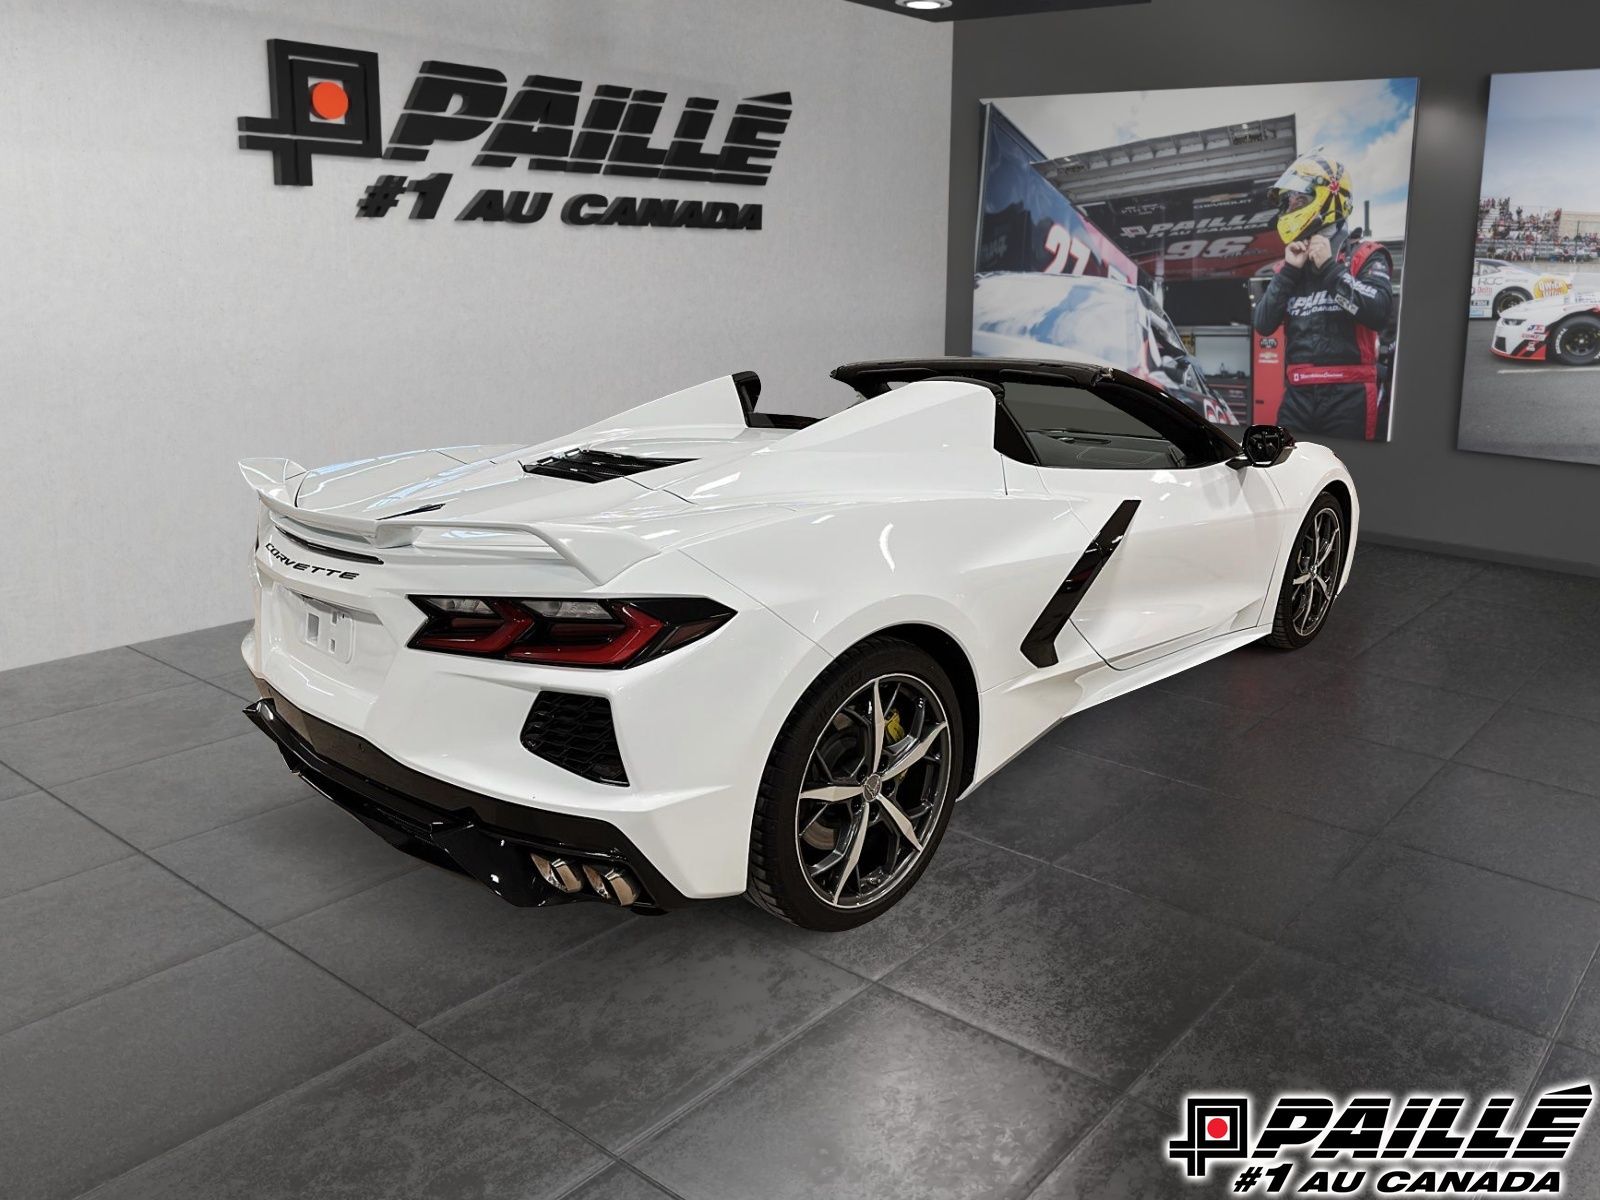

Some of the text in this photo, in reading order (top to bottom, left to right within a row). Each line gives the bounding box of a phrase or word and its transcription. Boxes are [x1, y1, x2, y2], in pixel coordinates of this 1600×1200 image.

[382, 60, 793, 186] PAILLÉ
[355, 173, 763, 230] #1 AU CANADA
[1164, 236, 1254, 260] 96
[1170, 229, 1191, 237] AU
[1196, 223, 1269, 234] CANADA
[265, 543, 360, 580] CORVETTE
